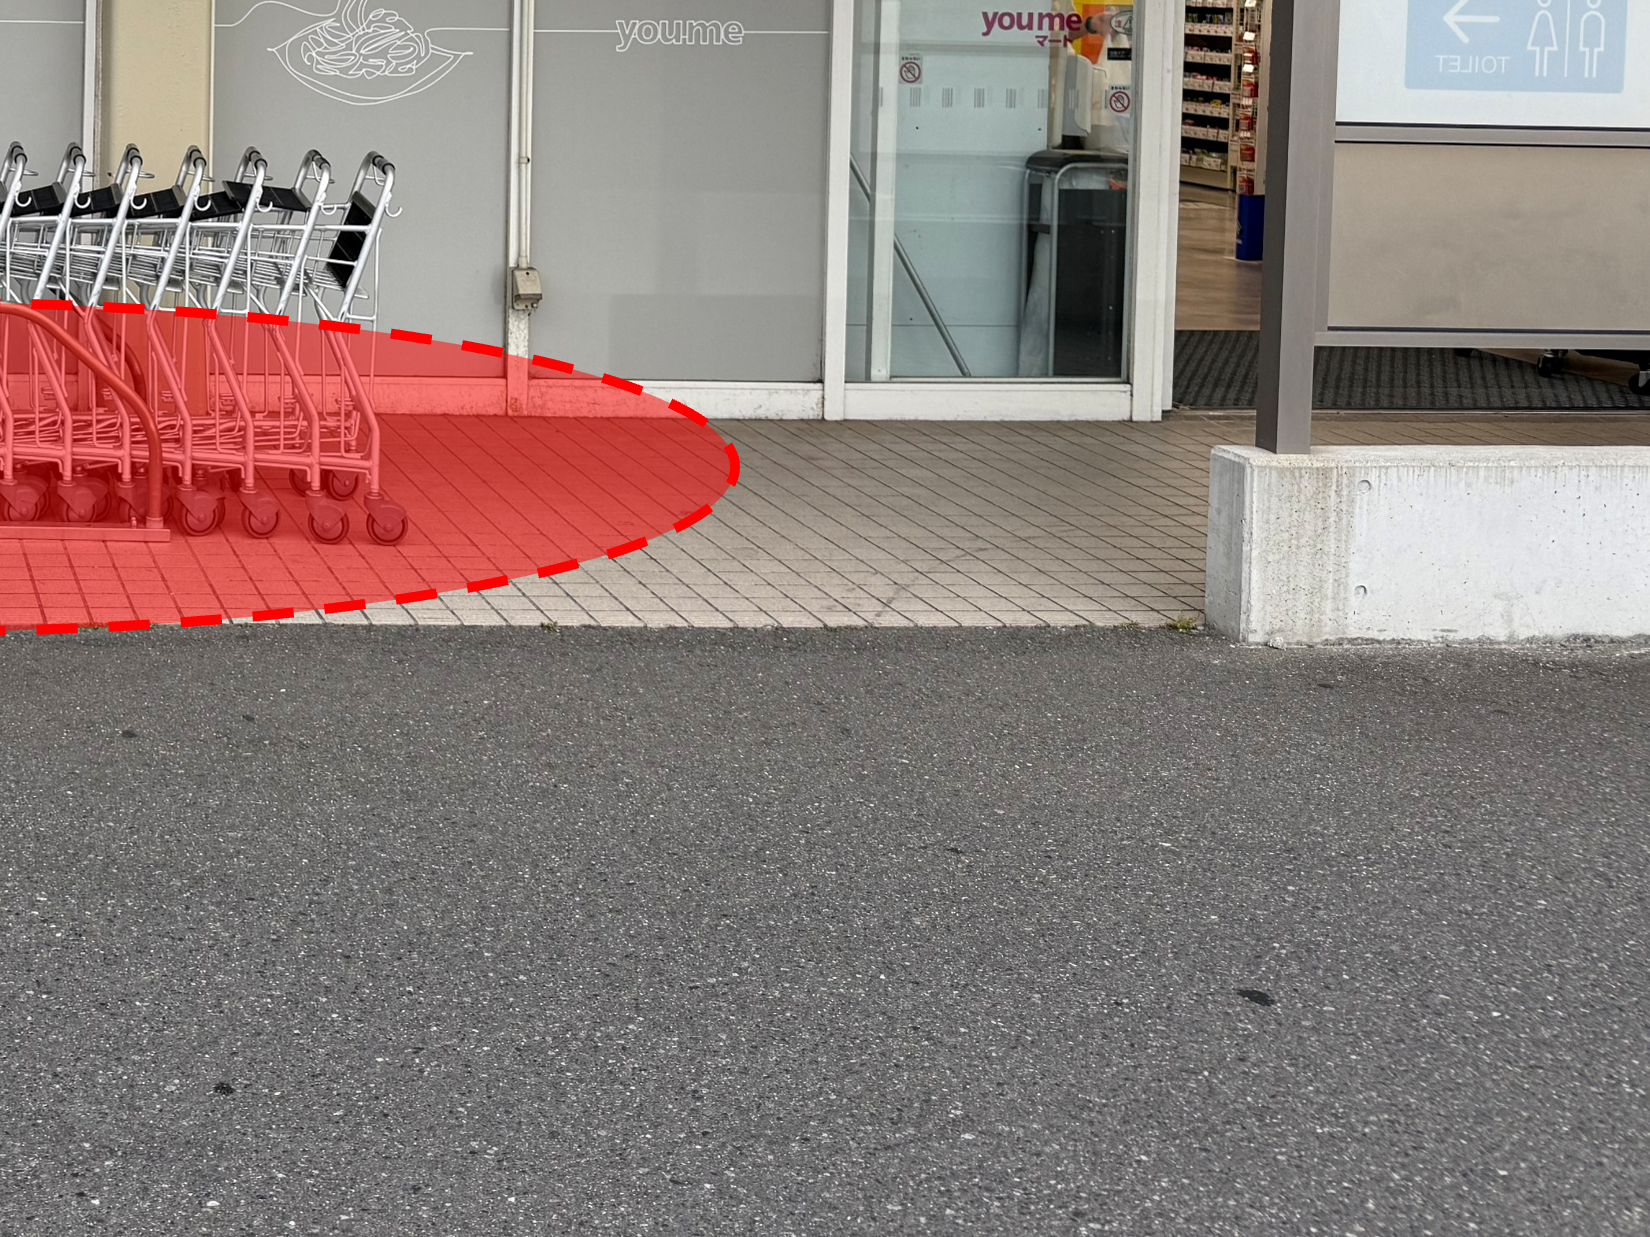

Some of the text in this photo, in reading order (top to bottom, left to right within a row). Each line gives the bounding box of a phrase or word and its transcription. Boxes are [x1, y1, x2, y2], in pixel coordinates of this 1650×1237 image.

[615, 20, 744, 52] youme
[982, 11, 1082, 37] youme
[1035, 34, 1073, 48] マート
